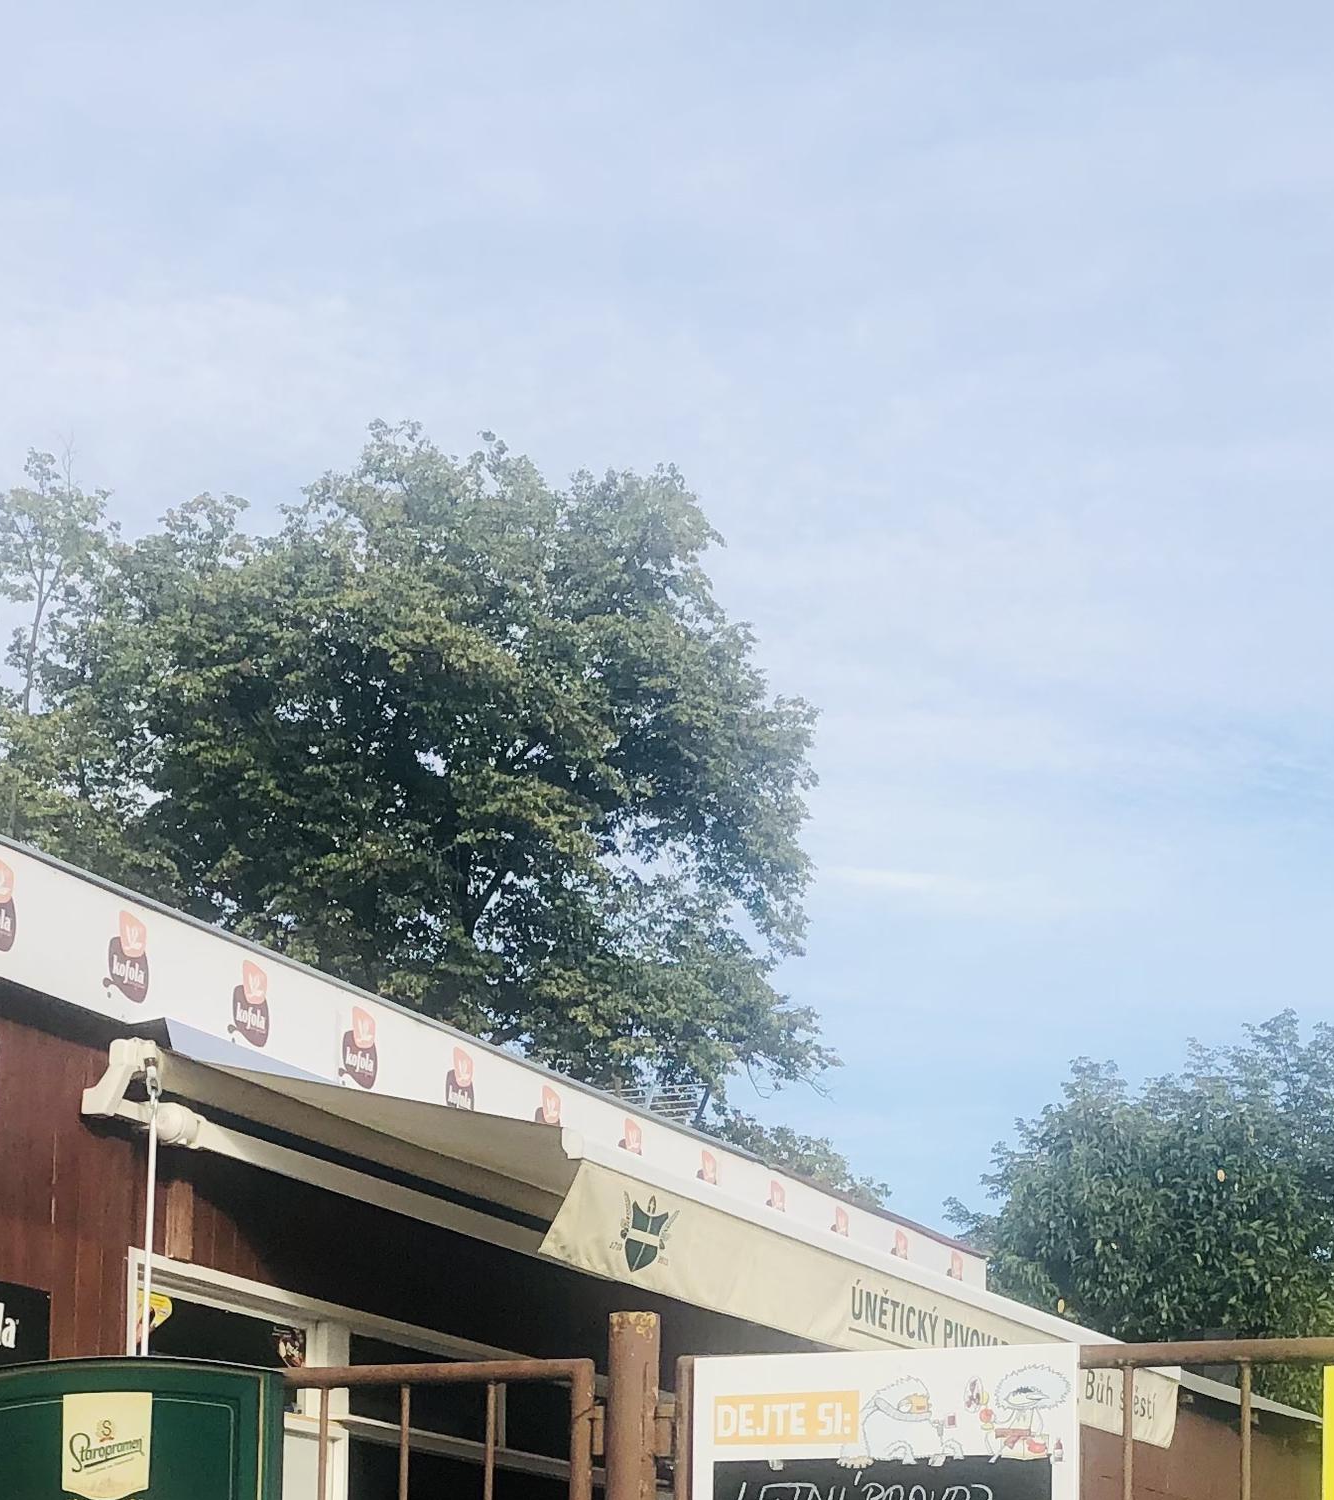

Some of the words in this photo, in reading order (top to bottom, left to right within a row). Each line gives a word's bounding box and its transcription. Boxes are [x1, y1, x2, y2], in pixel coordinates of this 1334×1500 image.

[112, 954, 145, 985] kofola
[235, 1002, 266, 1031] kofola
[346, 1046, 374, 1073] kofola
[851, 1279, 939, 1346] ÚNĚTICKÝ
[944, 1318, 1009, 1348] PIVO
[717, 1402, 806, 1437] DEJTE
[818, 1403, 852, 1436] SI:
[70, 1433, 145, 1473] Staropramen
